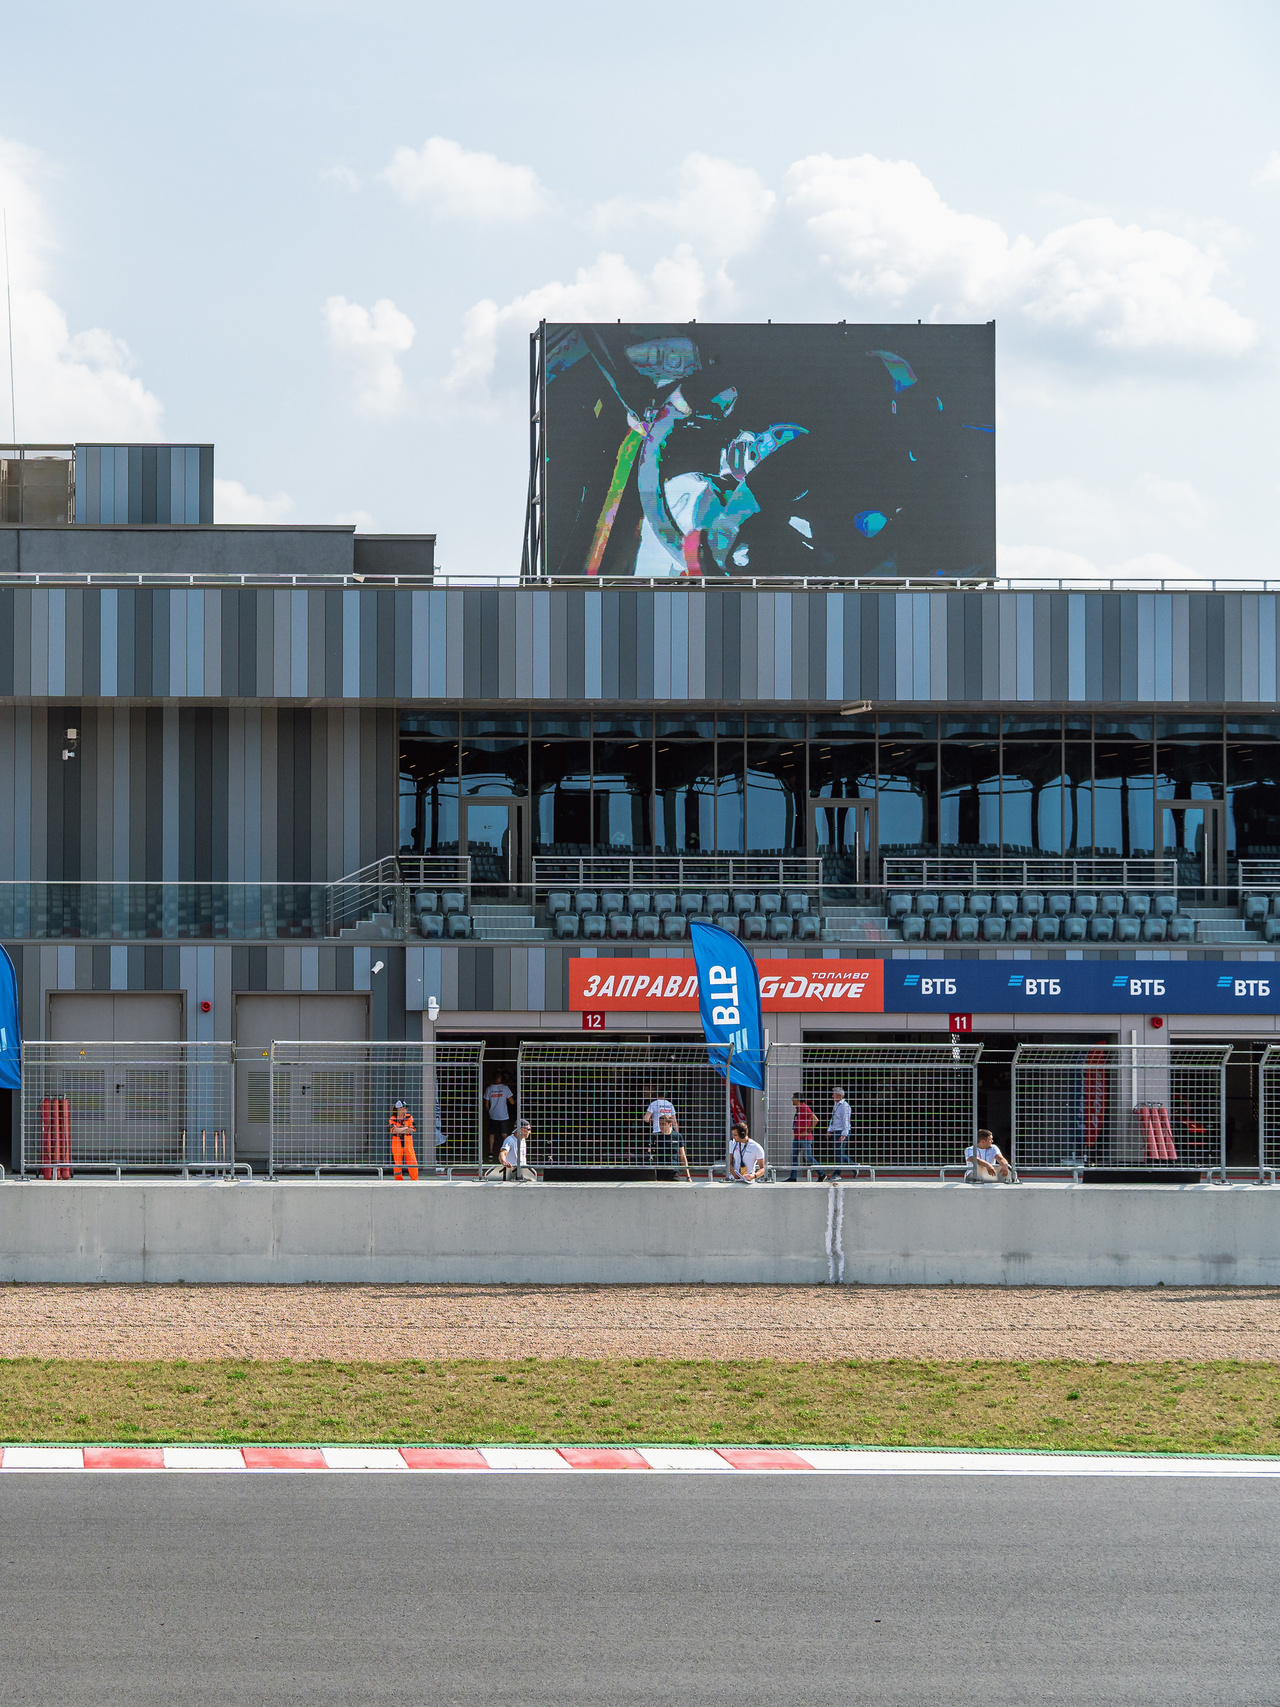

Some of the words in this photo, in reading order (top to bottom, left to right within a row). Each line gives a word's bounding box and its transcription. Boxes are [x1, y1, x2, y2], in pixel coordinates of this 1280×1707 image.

[811, 972, 870, 980] ТОПЛИВО
[583, 974, 700, 998] ЗАПРАВЛ
[920, 978, 958, 996] ВТБ
[1024, 978, 1062, 996] ВТБ
[1129, 979, 1167, 997] ВТБ
[1233, 979, 1272, 997] ВТБ
[586, 1014, 602, 1028] 12
[953, 1016, 968, 1030] 11
